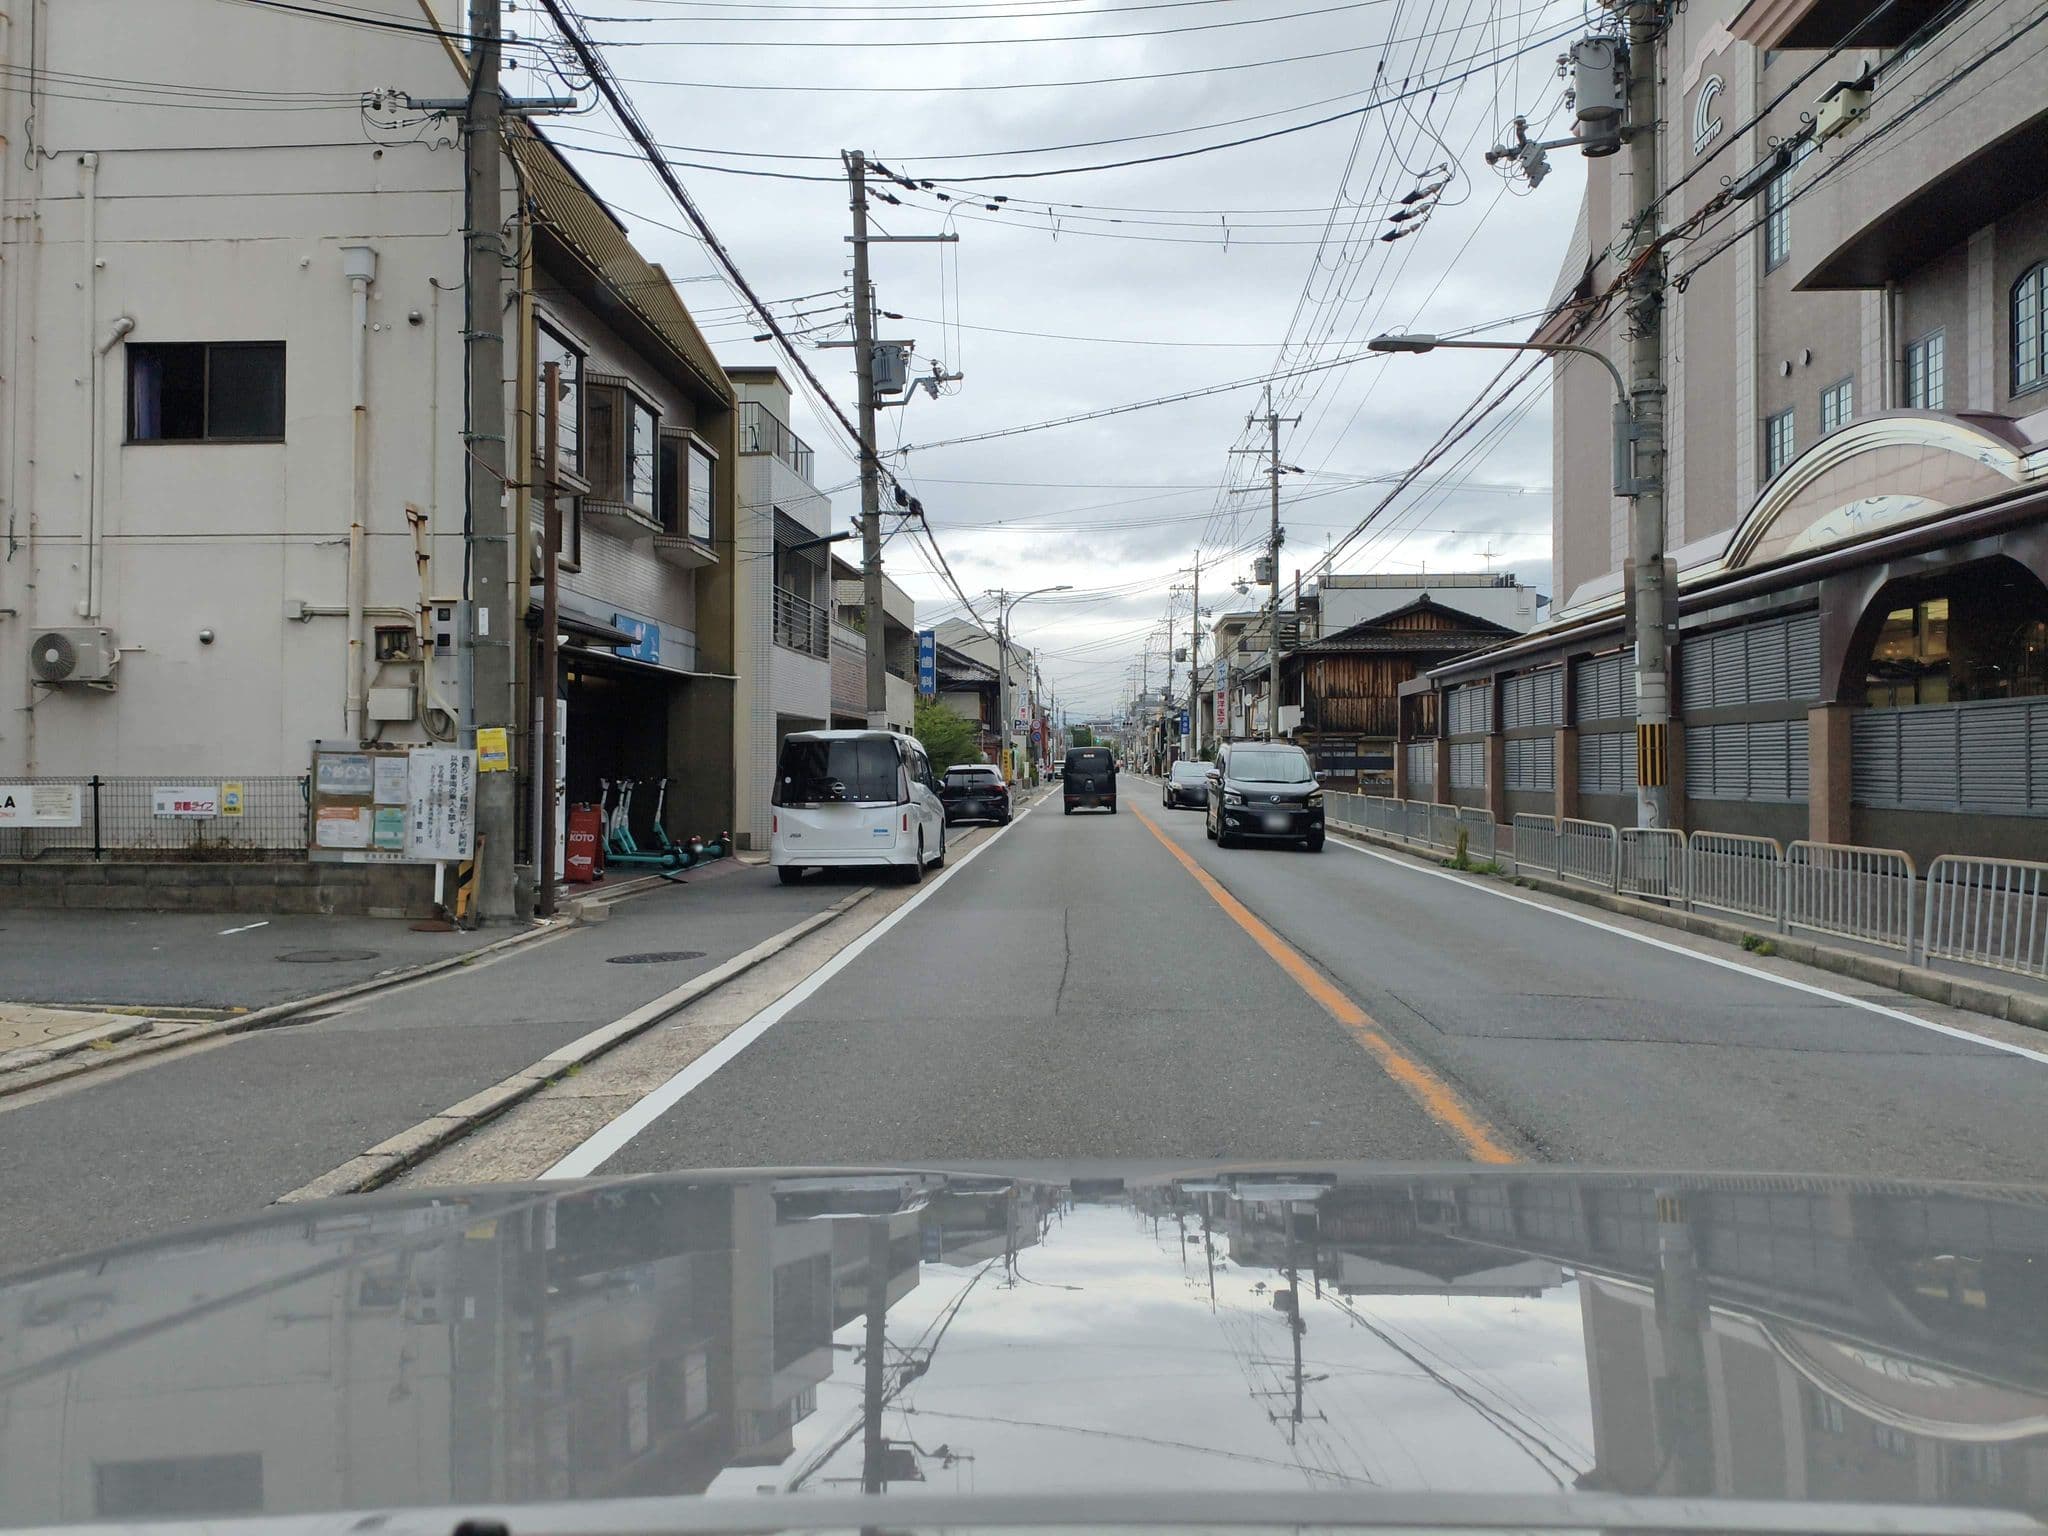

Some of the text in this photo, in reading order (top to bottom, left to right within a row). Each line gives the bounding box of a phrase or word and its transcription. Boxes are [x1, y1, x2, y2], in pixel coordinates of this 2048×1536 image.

[174, 801, 214, 812] 京都ライフ
[569, 833, 595, 842] KOTO
